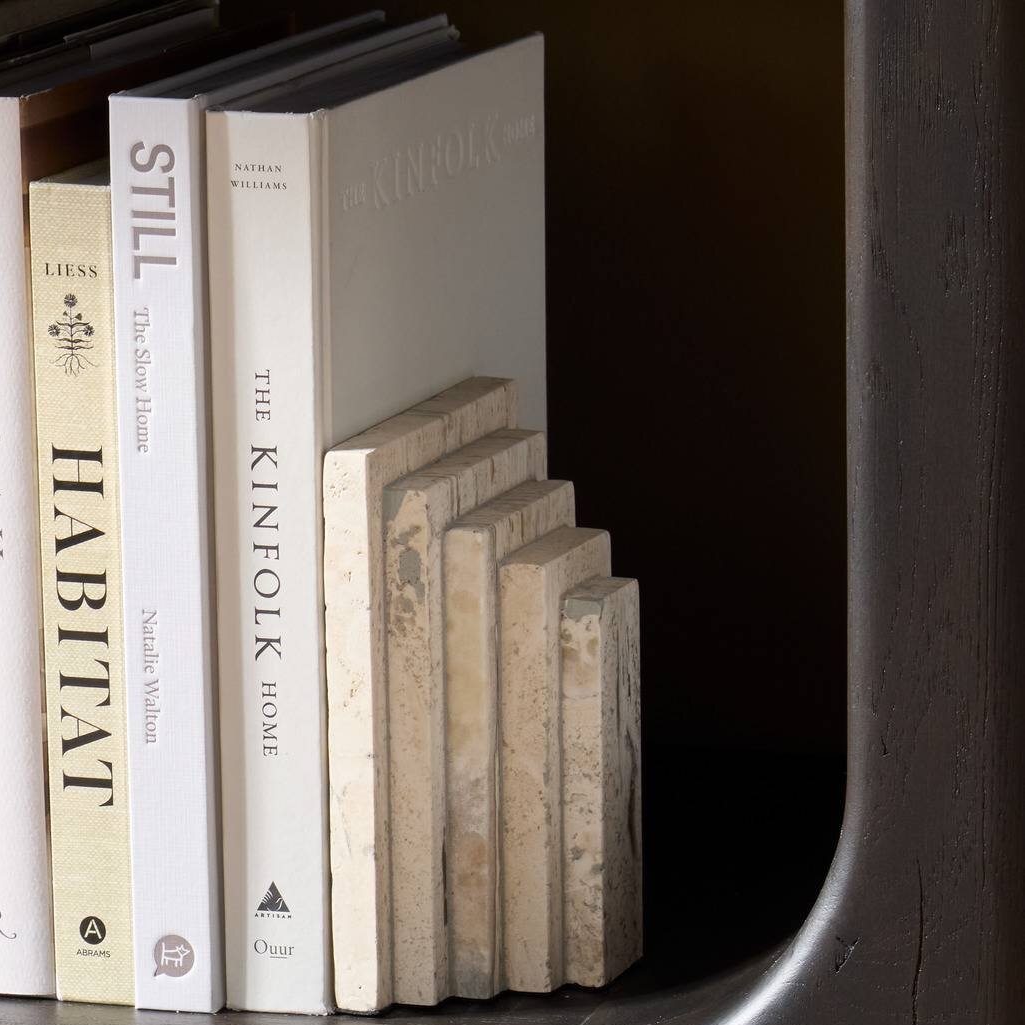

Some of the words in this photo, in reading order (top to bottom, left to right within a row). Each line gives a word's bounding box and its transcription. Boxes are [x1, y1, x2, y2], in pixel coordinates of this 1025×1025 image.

[230, 180, 288, 190] WILLIAMS
[235, 163, 282, 174] NATHAN
[369, 113, 501, 210] KINFOLK
[130, 141, 177, 280] STILL
[45, 262, 98, 278] LIESS
[133, 307, 151, 345] The
[136, 349, 152, 393] Slow
[255, 369, 271, 422] THE
[137, 397, 152, 454] Home
[250, 444, 282, 661] KINFOLK
[51, 442, 114, 808] HABITAT
[141, 609, 159, 674] Natalie
[145, 678, 161, 745] Walton
[261, 682, 278, 757] HOME
[76, 949, 111, 958] ABRAMS
[254, 939, 295, 956] Ouur
